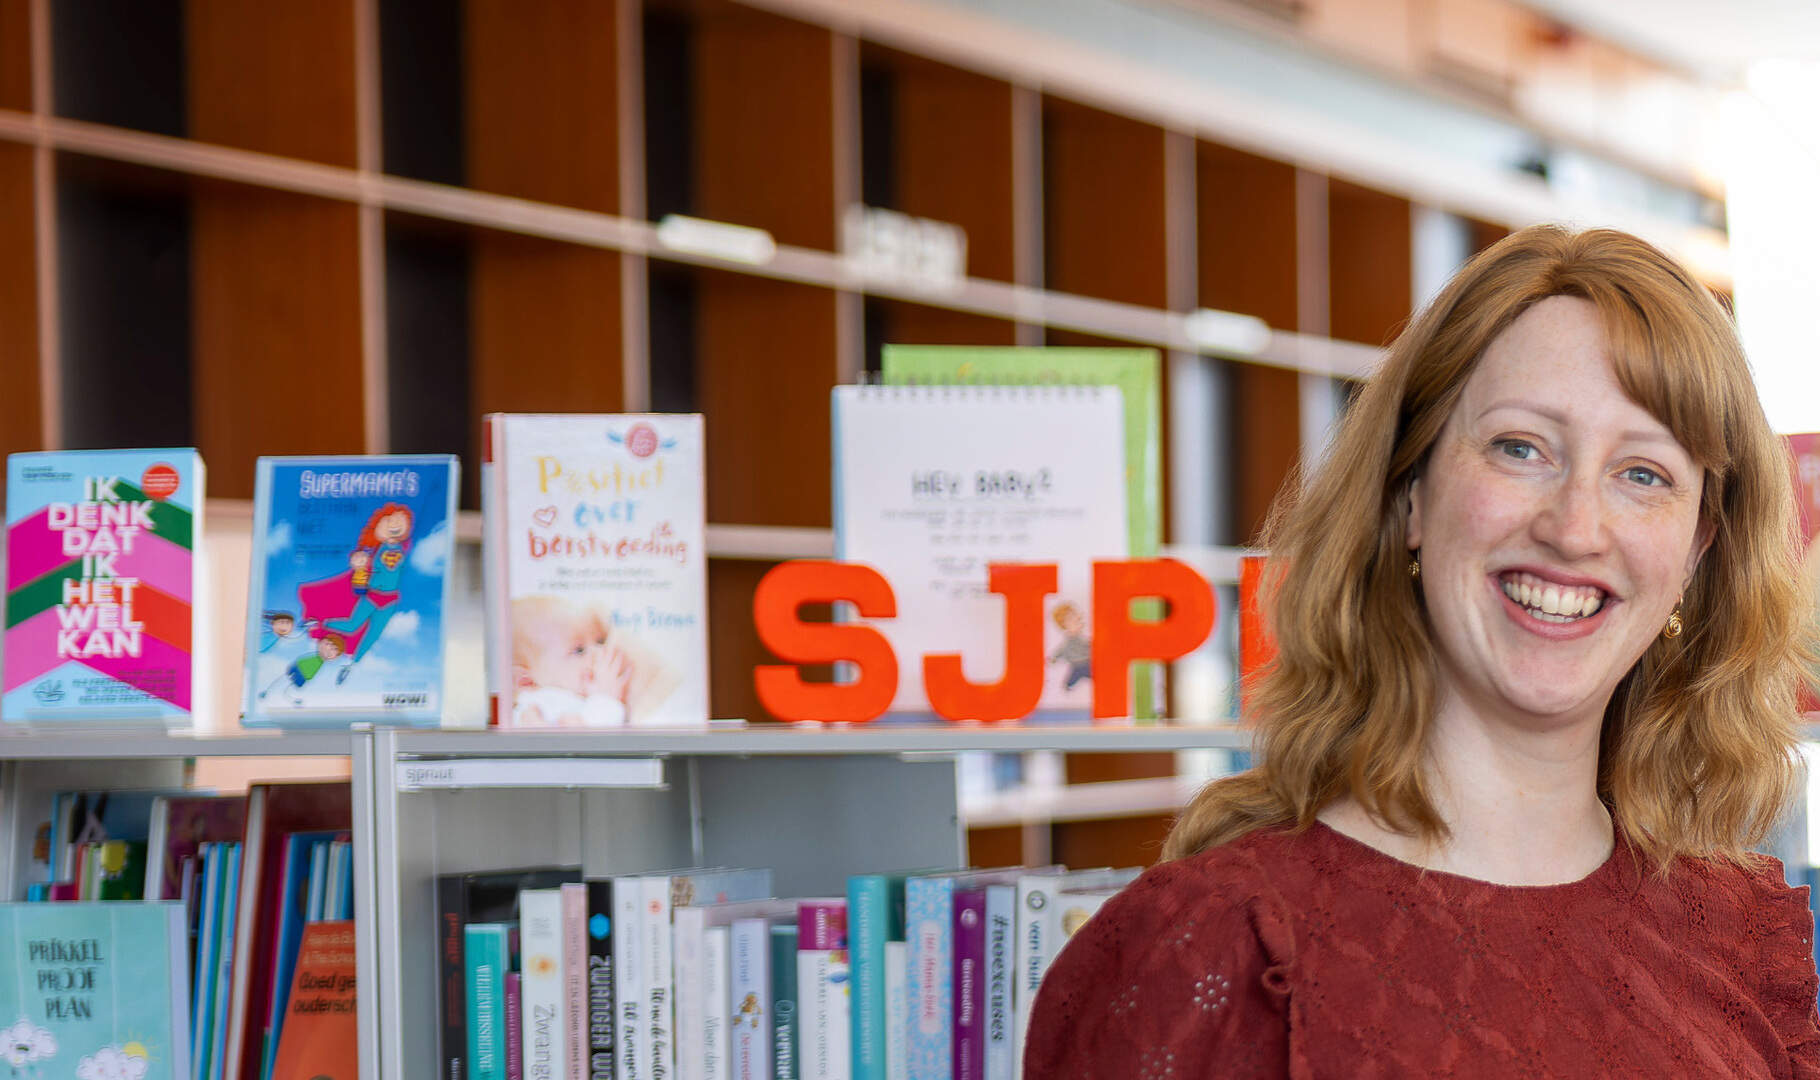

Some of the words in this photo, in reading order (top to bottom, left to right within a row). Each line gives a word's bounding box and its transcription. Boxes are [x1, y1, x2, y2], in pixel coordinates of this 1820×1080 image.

[84, 476, 121, 501] IK
[300, 469, 421, 499] SUPERMAMA'S
[48, 501, 156, 530] DENK
[62, 526, 139, 555] DAT
[82, 551, 120, 578] IK
[62, 577, 139, 605] HET
[56, 603, 146, 632] WEL
[57, 629, 145, 659] KAN
[990, 914, 1011, 1042] #noexcuses
[45, 995, 92, 1020] PLAN
[589, 955, 613, 1047] ZWANGER
